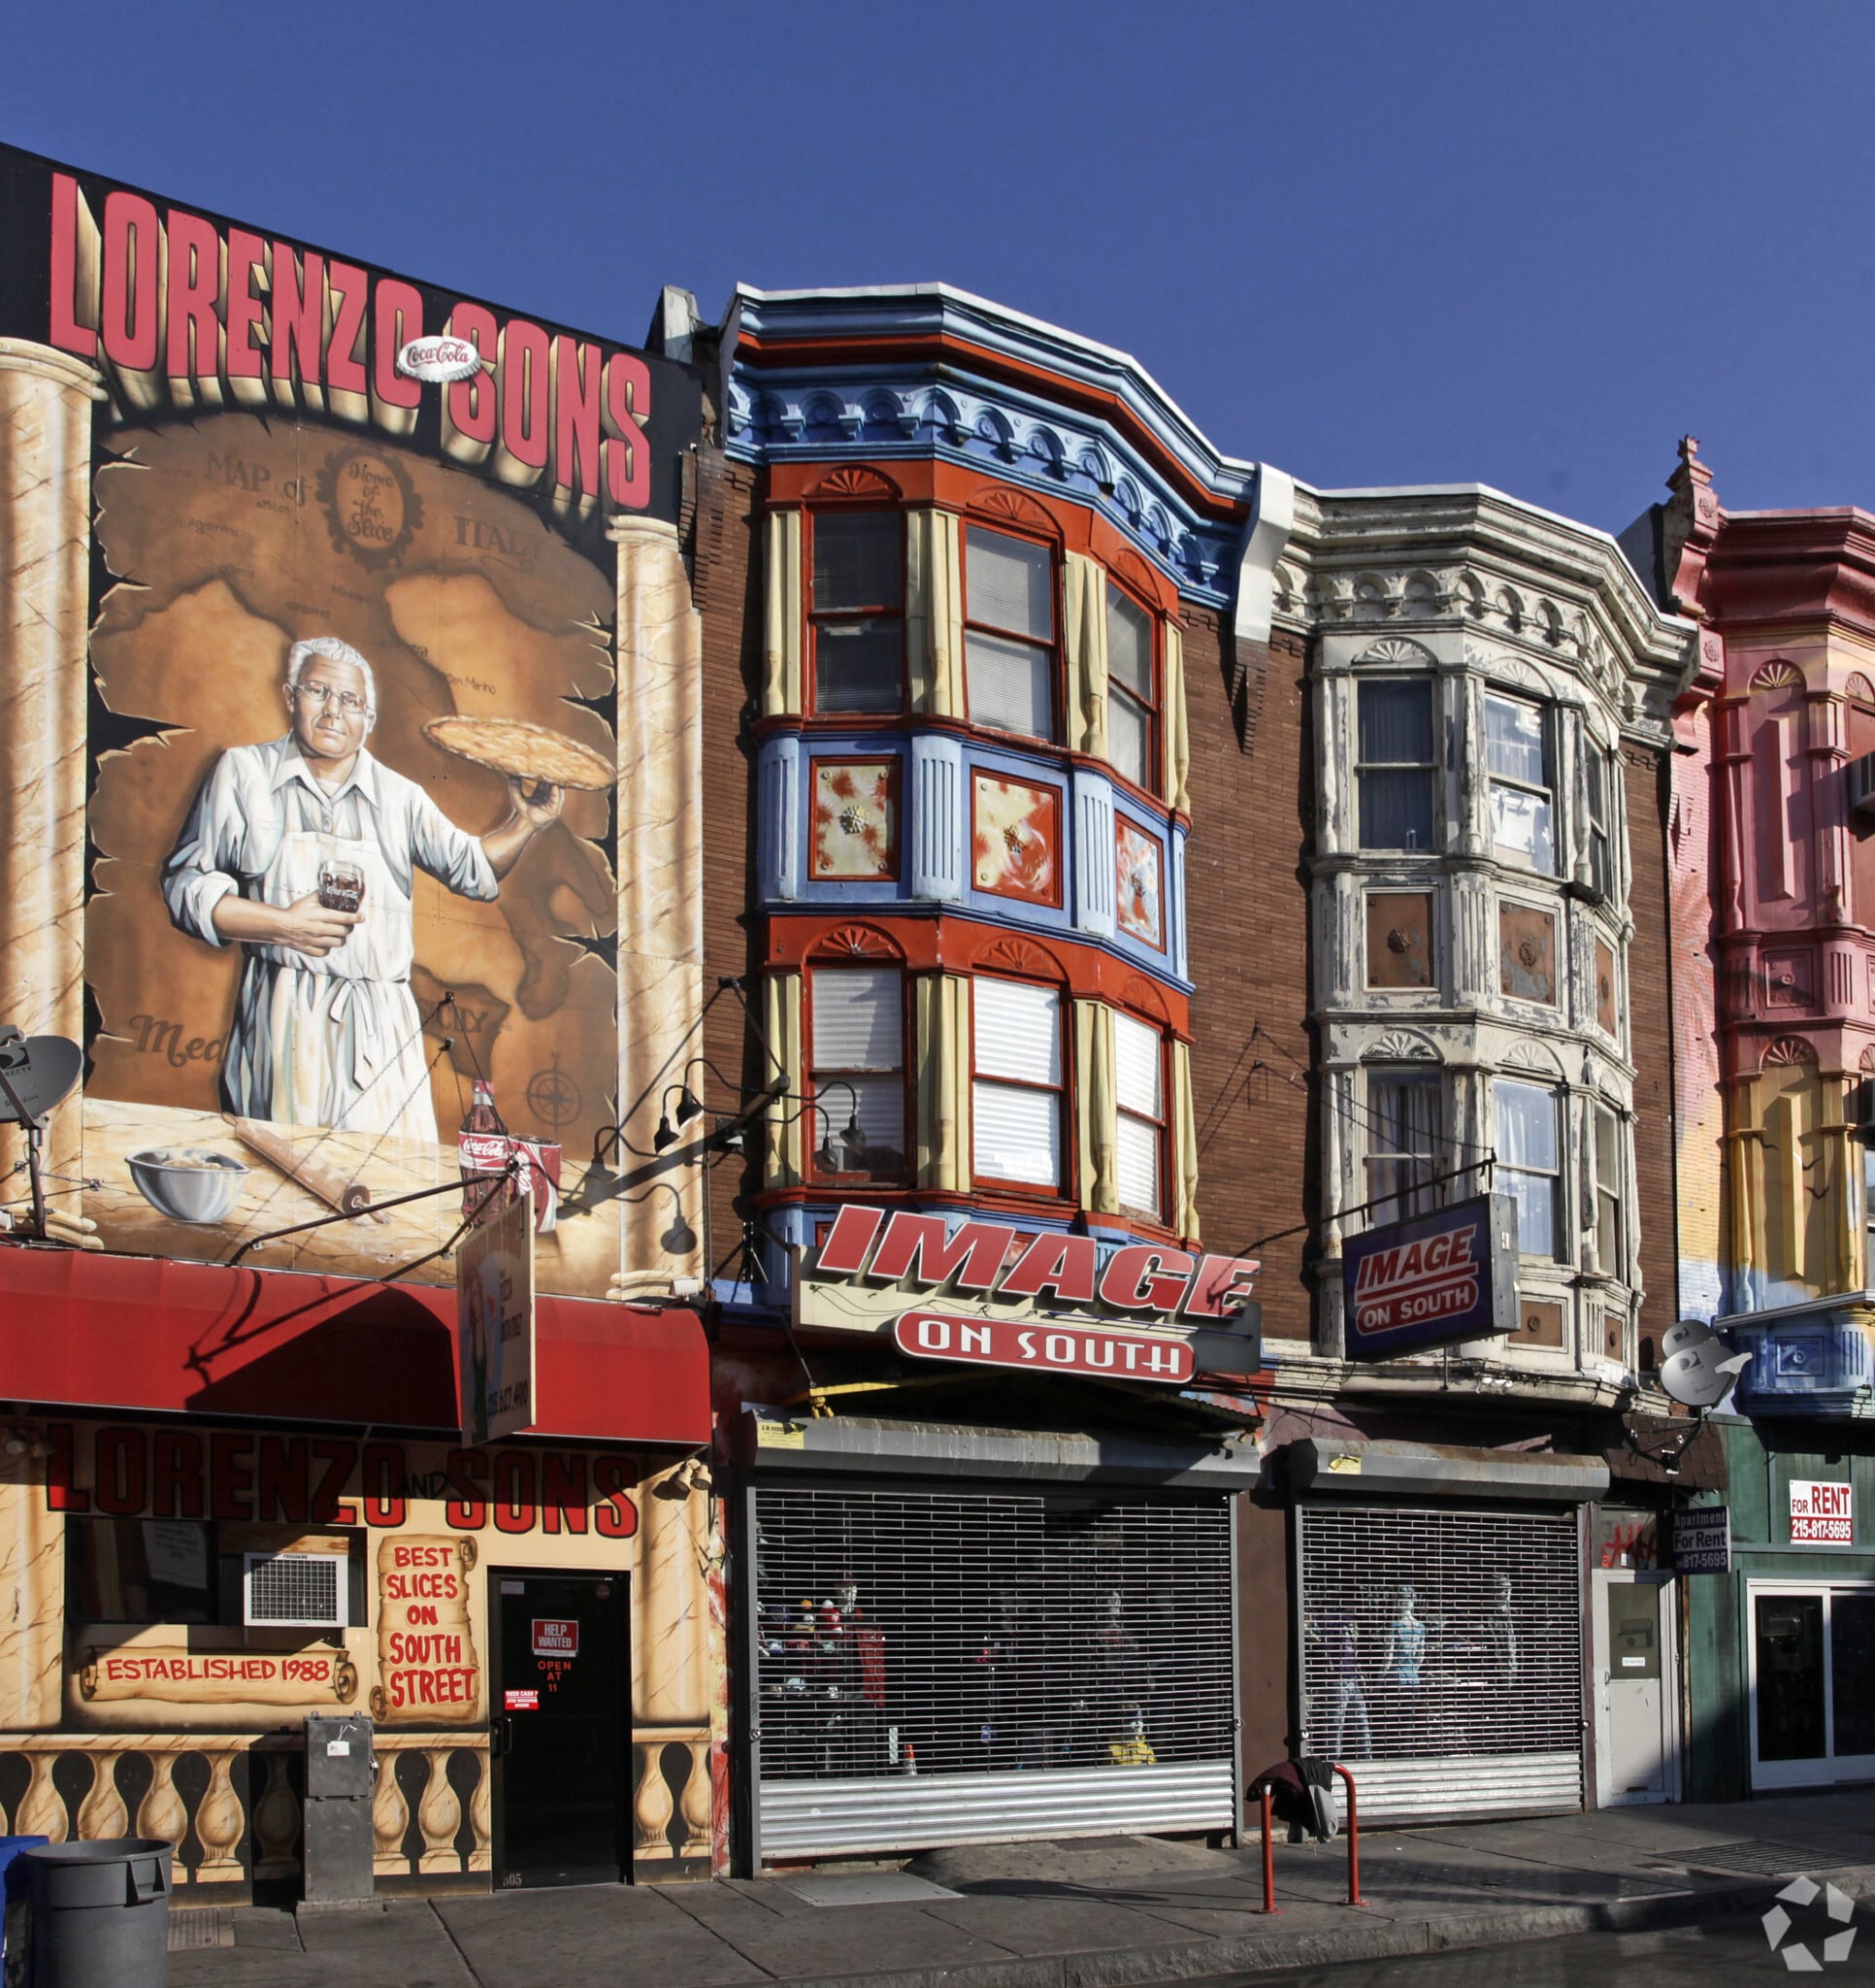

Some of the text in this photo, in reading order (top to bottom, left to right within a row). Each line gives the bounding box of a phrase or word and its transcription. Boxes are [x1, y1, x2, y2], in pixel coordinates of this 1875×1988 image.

[49, 171, 652, 511] LORENZO SONS
[406, 341, 471, 369] Coca-Cola
[203, 449, 272, 493] MAP
[348, 462, 395, 489] Home
[362, 485, 381, 503] of
[347, 512, 394, 543] Slice
[817, 1204, 1262, 1319] IMAGE
[1356, 1225, 1476, 1291] IMAGE
[1363, 1285, 1469, 1328] ON SOUTH
[917, 1319, 1181, 1375] ON SOUTH
[47, 1423, 407, 1529] LORENZO
[444, 1446, 640, 1540] SONS
[1792, 1485, 1850, 1515] FOR RENT
[1674, 1509, 1726, 1530] Apartment
[1792, 1518, 1852, 1540] 215-817-5695
[1674, 1532, 1694, 1550] For
[1695, 1530, 1727, 1548] Rent
[394, 1546, 453, 1568] BEST
[386, 1573, 459, 1600] SLICES
[407, 1605, 439, 1626] ON
[538, 1636, 573, 1649] WANTED
[543, 1623, 568, 1638] HELP
[389, 1632, 462, 1665] SOUTH
[106, 1658, 331, 1682] ESTABLISHED 1988
[537, 1660, 573, 1672] OPEN
[546, 1672, 563, 1682] AT
[390, 1668, 477, 1708] STREET
[547, 1683, 558, 1693] 11
